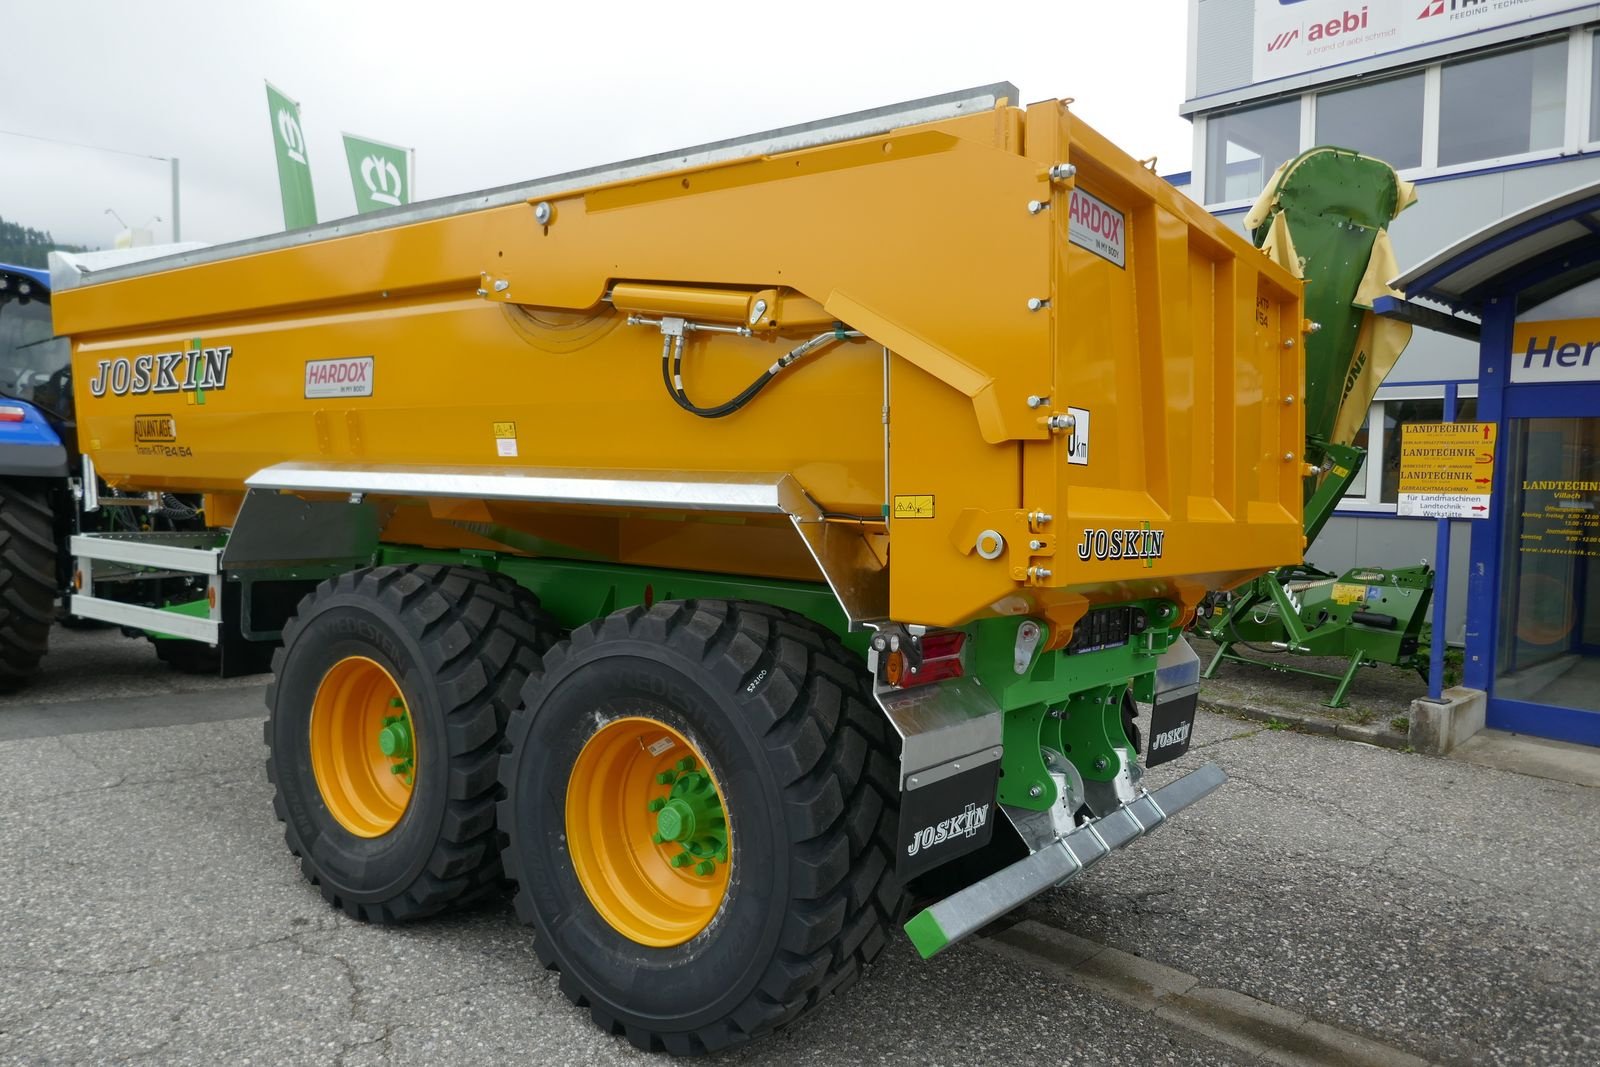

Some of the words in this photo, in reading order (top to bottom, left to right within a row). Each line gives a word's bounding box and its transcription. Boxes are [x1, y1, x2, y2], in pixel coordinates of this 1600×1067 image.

[1450, 6, 1488, 20] FEEDING
[1308, 6, 1368, 42] aebi
[1313, 43, 1336, 55] brand
[1337, 40, 1346, 50] of
[1346, 37, 1363, 48] aebi
[1365, 28, 1397, 42] schmidt
[1095, 238, 1100, 248] IN
[1523, 335, 1600, 369] Her
[90, 346, 233, 398] JOSKIN
[308, 362, 369, 385] HARDOX
[135, 419, 173, 438] ADVANTAGE
[1406, 424, 1479, 434] LANDTECHNIK
[1403, 448, 1476, 457] LANDTECHNIK
[1400, 471, 1473, 480] LANDTECHNIK
[1522, 480, 1600, 491] LANDTECHN
[1420, 503, 1465, 511] Landtechnik-
[1421, 495, 1481, 503] Landmaschinen
[1077, 528, 1165, 562] JOSKIN
[1152, 722, 1190, 751] JOSKIN
[907, 803, 989, 857] JOSKIN
